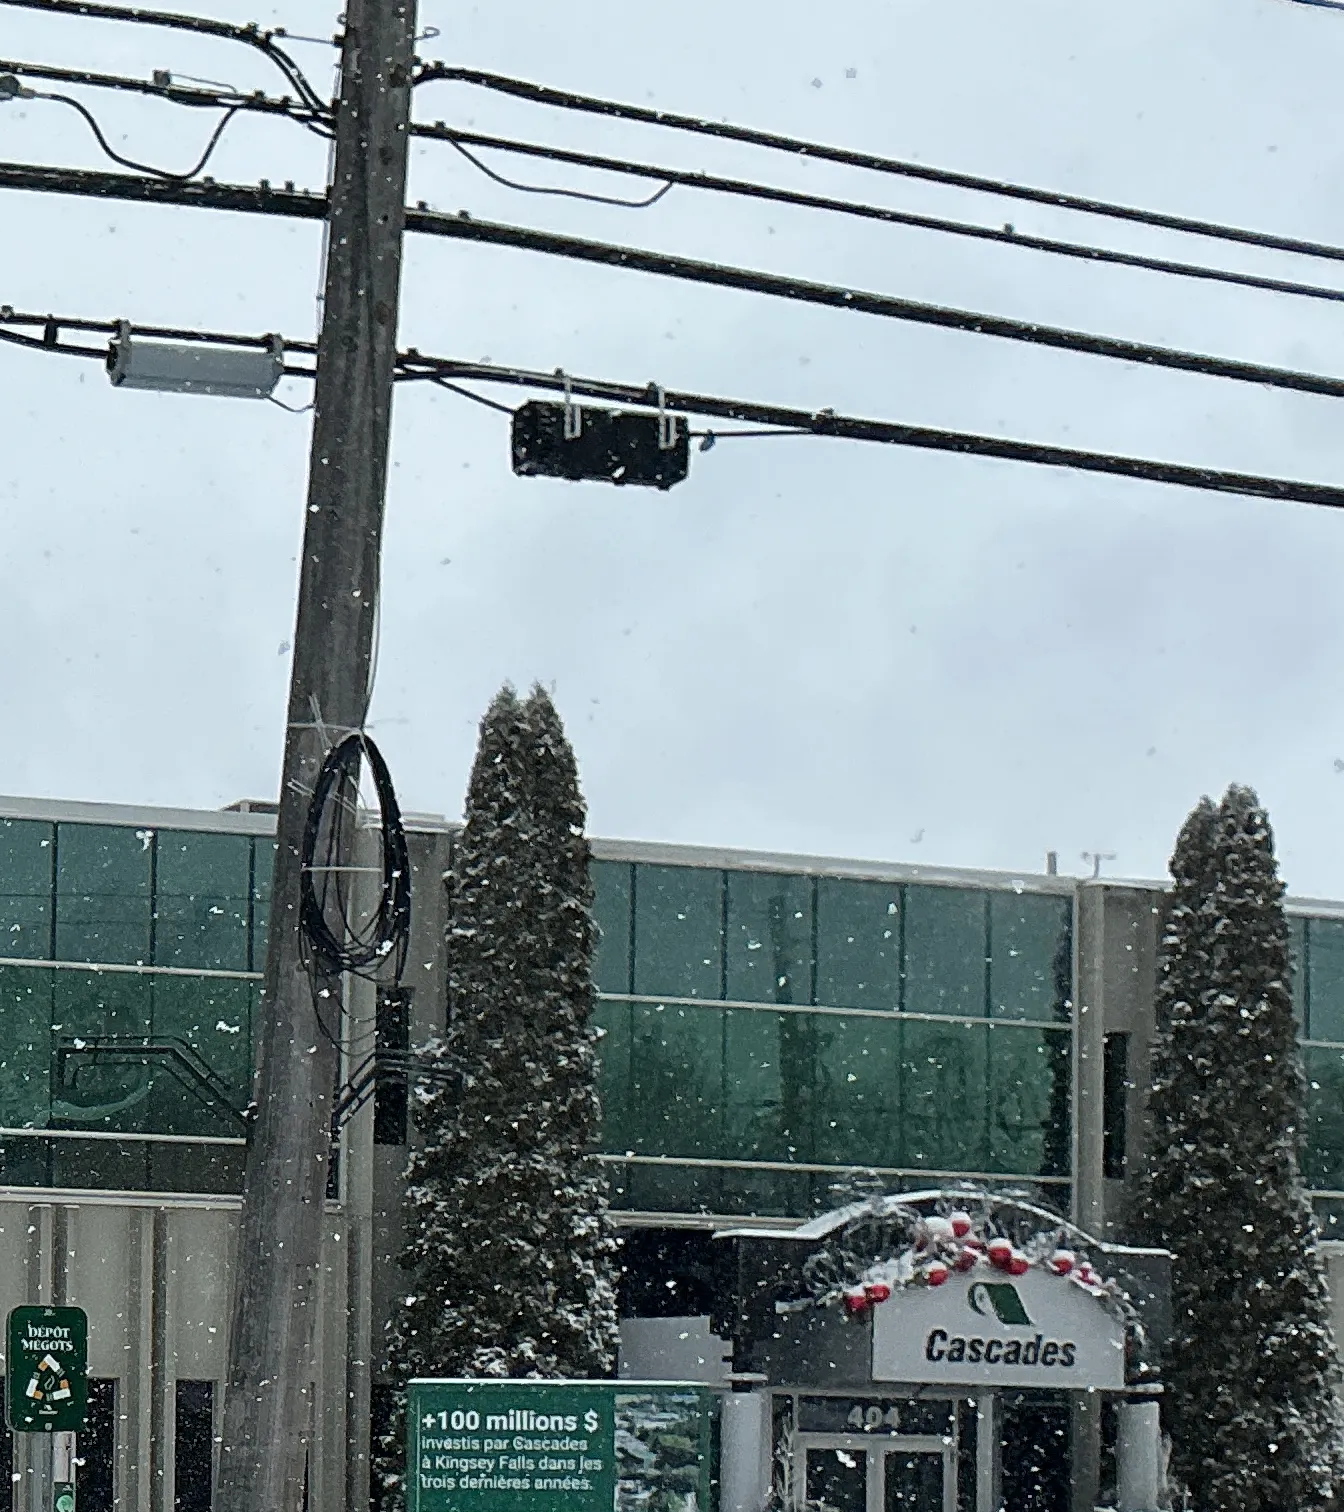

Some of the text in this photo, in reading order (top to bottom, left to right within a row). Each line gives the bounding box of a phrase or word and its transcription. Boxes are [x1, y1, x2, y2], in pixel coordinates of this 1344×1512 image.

[27, 1325, 70, 1338] DÉPÔT
[21, 1338, 73, 1351] MÉGOTS
[925, 1329, 1077, 1368] Cascades
[421, 1408, 599, 1433] +100 millions $
[847, 1405, 901, 1427] 404
[421, 1436, 588, 1452] investis par Cascades
[421, 1455, 603, 1473] à Kingsey Falls dans les
[421, 1475, 593, 1490] trois dernières années.
